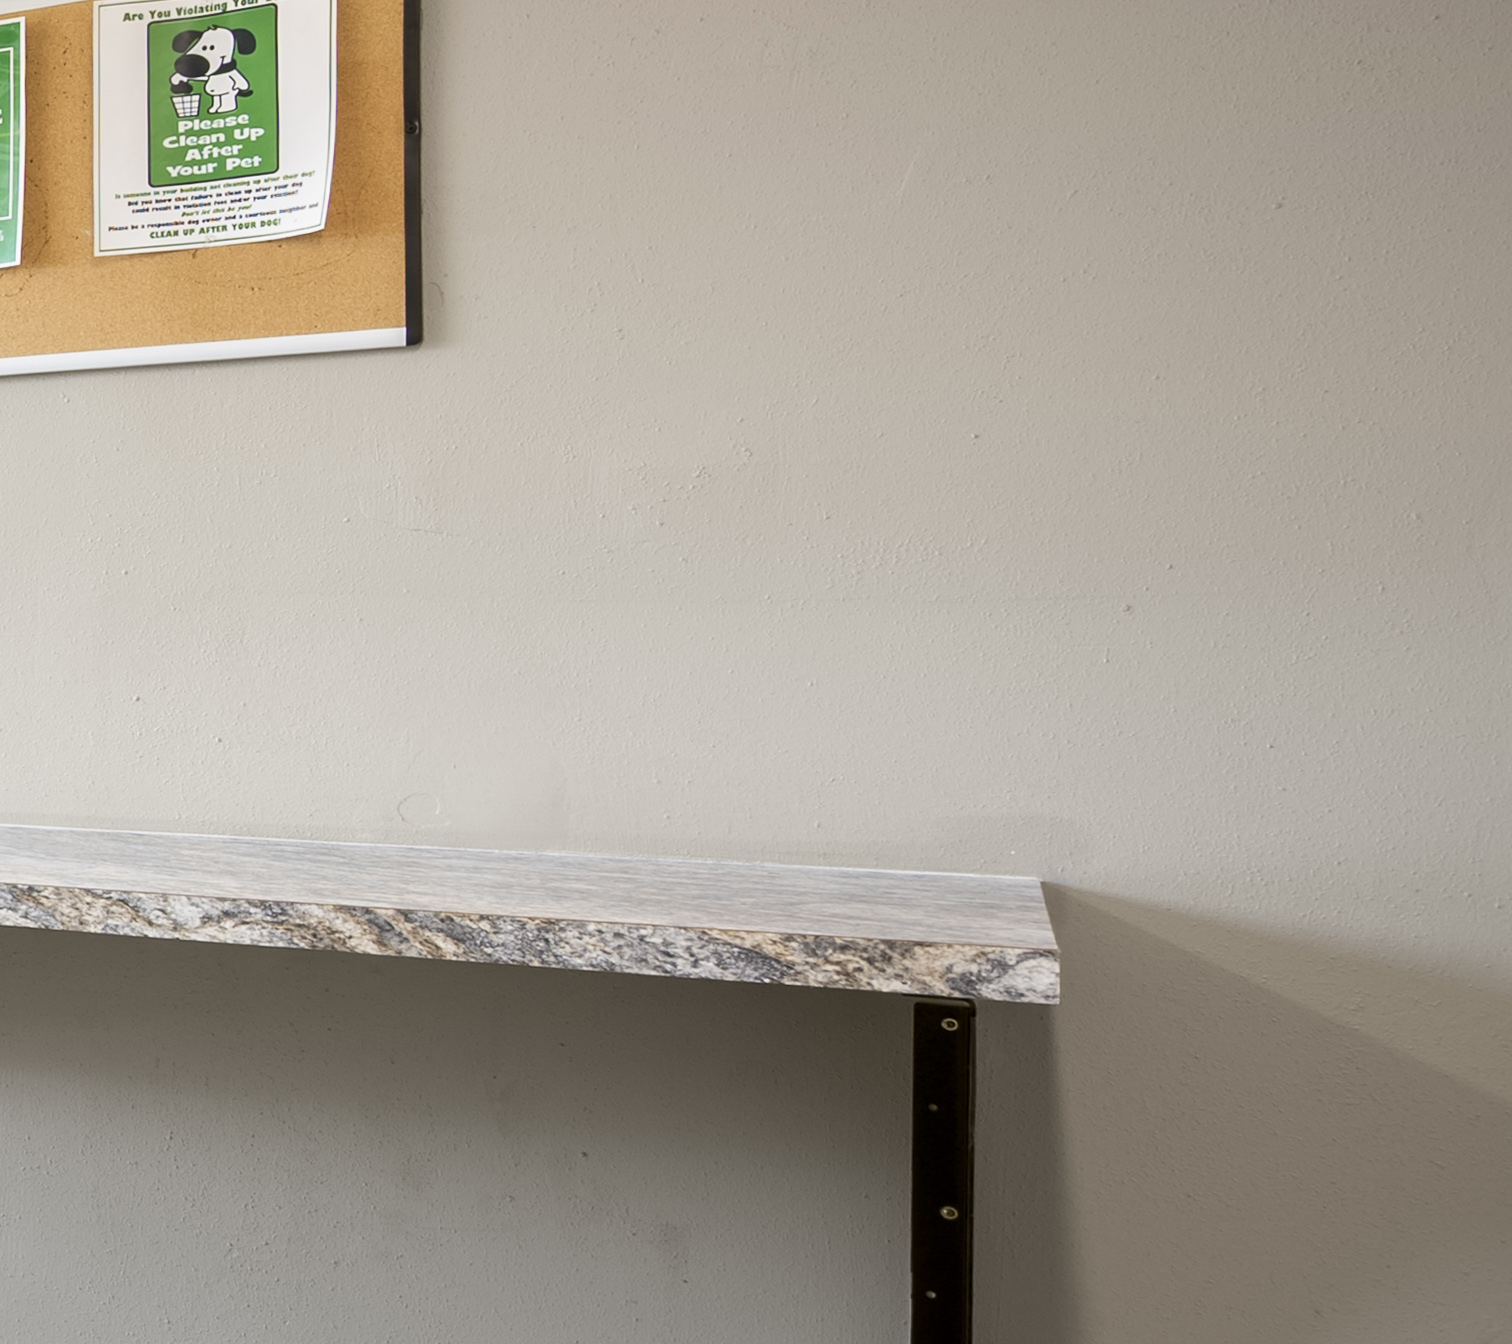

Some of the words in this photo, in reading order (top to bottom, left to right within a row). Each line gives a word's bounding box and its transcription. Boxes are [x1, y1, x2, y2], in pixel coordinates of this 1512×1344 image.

[123, 12, 144, 22] Are
[149, 10, 171, 19] You
[175, 1, 228, 16] Violating
[177, 113, 250, 133] Please
[162, 131, 225, 148] Clean
[234, 127, 265, 141] Up
[185, 144, 243, 161] After
[166, 162, 218, 177] Your
[226, 155, 262, 171] Pet
[180, 185, 207, 194] building
[223, 180, 251, 190] cleaning
[183, 201, 211, 209] violation
[253, 194, 267, 202] your
[147, 220, 185, 228] responsible
[202, 216, 222, 224] owner
[150, 230, 179, 239] CLEAN
[183, 228, 195, 236] UP
[198, 225, 228, 234] AFTER
[232, 221, 256, 230] YOUR
[261, 218, 282, 227] DOG!
